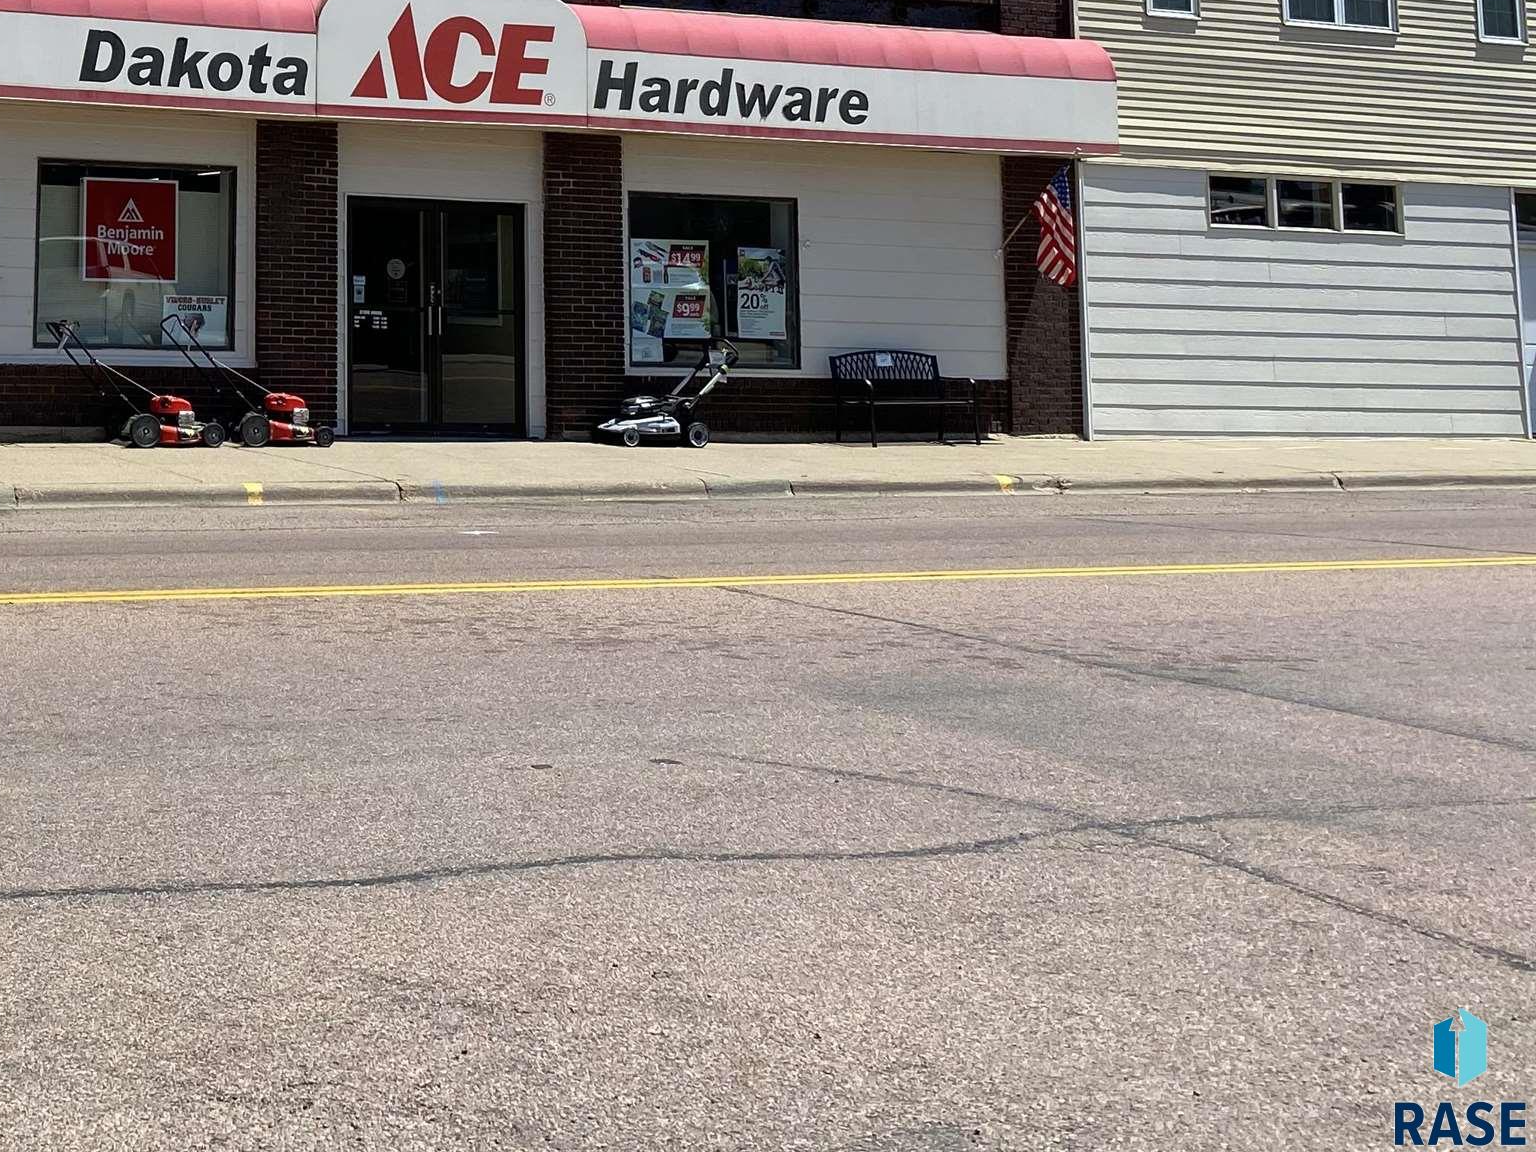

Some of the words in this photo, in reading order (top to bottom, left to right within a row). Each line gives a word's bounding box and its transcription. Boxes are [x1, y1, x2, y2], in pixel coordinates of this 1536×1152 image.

[78, 29, 309, 96] Dakota
[350, 2, 555, 106] ACE
[593, 59, 869, 125] Hardware
[97, 224, 164, 242] Benjamin
[107, 240, 154, 256] Moore
